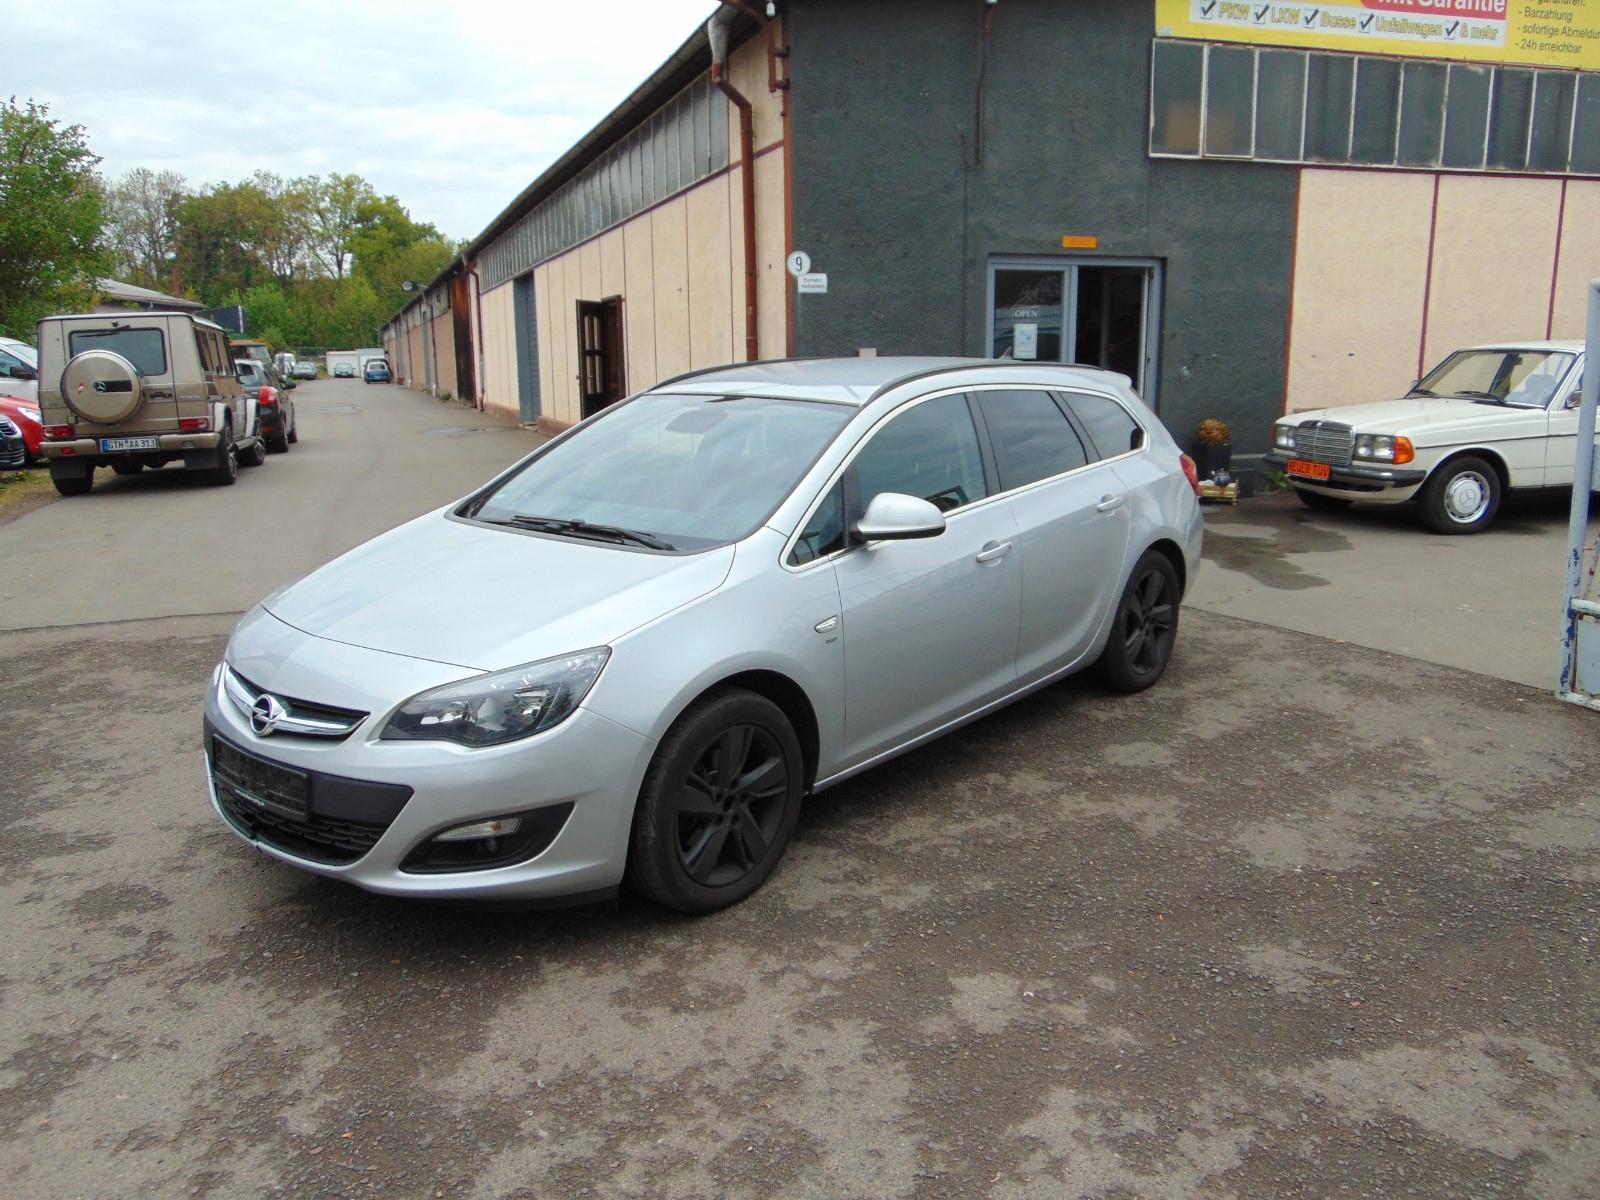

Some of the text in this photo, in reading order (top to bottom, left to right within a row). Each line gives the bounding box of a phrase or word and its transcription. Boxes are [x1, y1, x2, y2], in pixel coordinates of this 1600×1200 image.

[1218, 2, 1250, 20] PKW
[1271, 7, 1301, 24] LKW
[1320, 11, 1357, 29] Busse
[1375, 15, 1443, 38] Unfallwagen
[1470, 25, 1499, 41] mehr
[1524, 6, 1573, 23] Barzahlung
[1522, 23, 1559, 38] sofortige
[1520, 38, 1582, 53] 24h erreichbar
[795, 256, 803, 271] 9
[1014, 309, 1038, 318] OPEN
